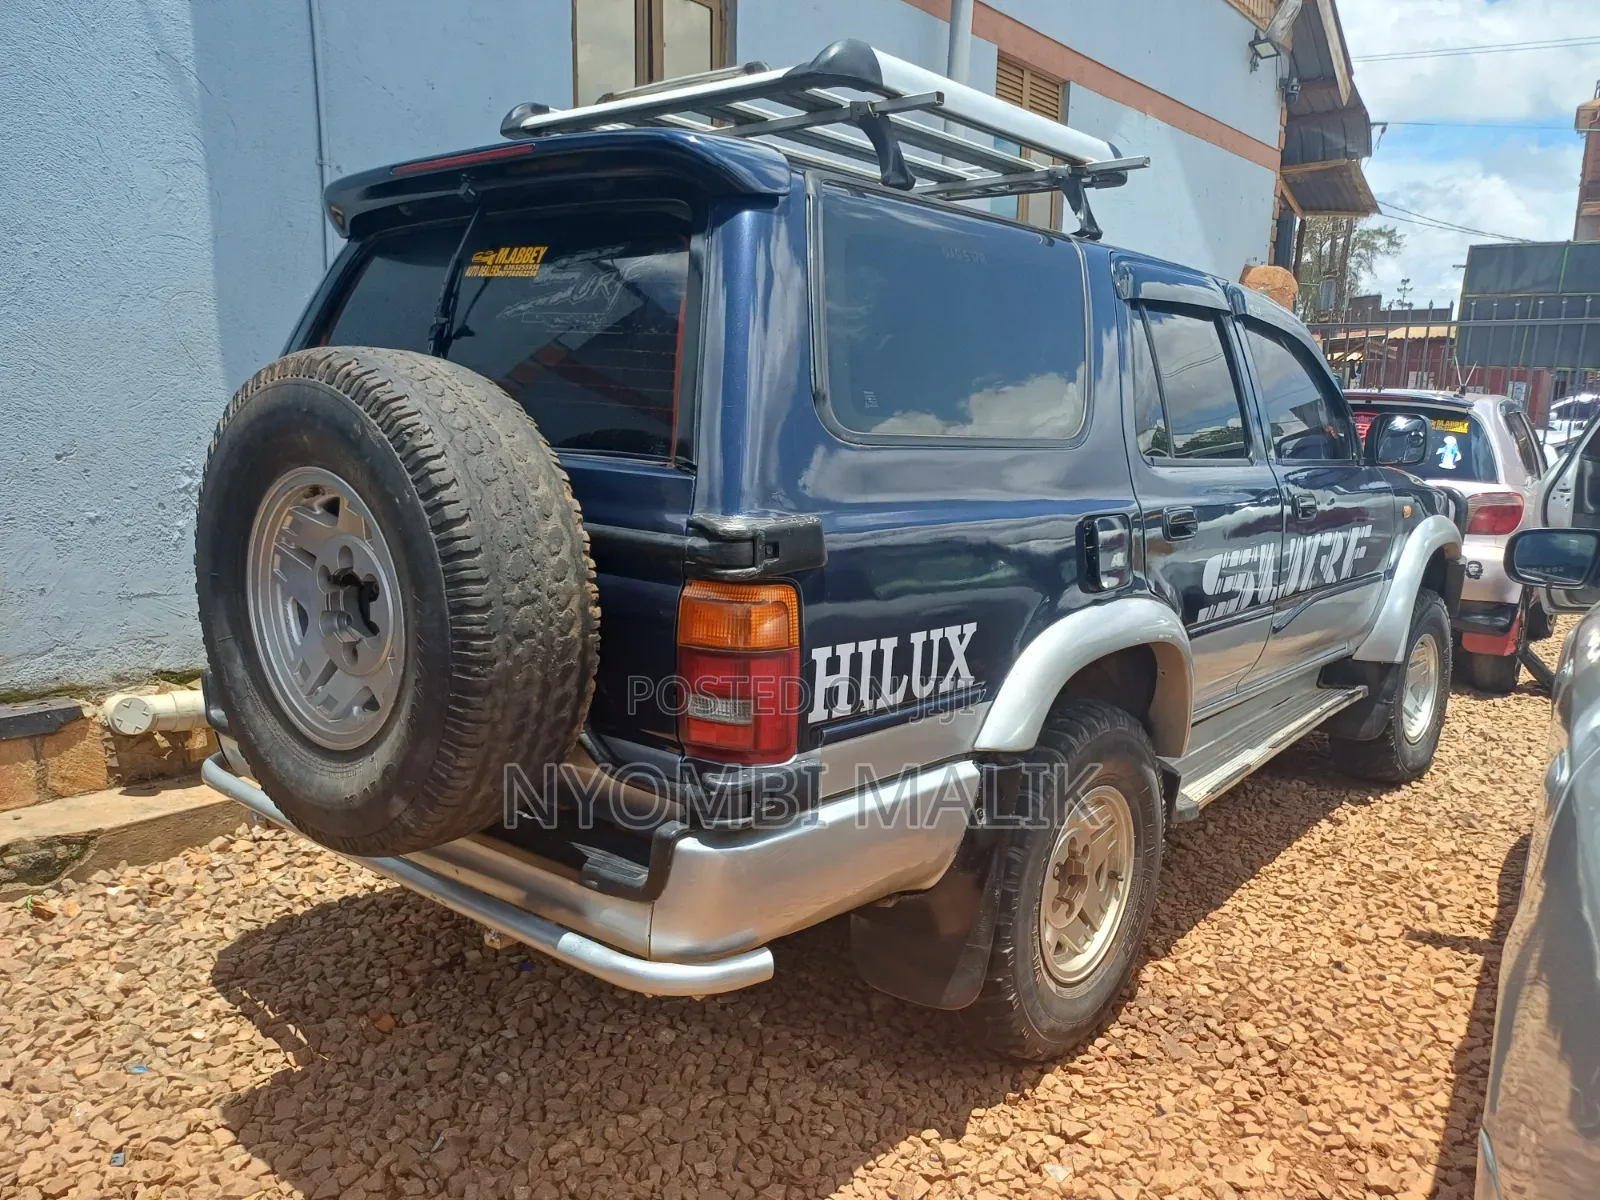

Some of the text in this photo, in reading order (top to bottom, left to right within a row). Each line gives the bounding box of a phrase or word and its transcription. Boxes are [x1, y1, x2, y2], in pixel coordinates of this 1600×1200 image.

[465, 265, 480, 277] AUTO
[494, 246, 548, 264] M.ABBEY
[1197, 524, 1373, 623] SURF
[807, 622, 979, 724] HILUX
